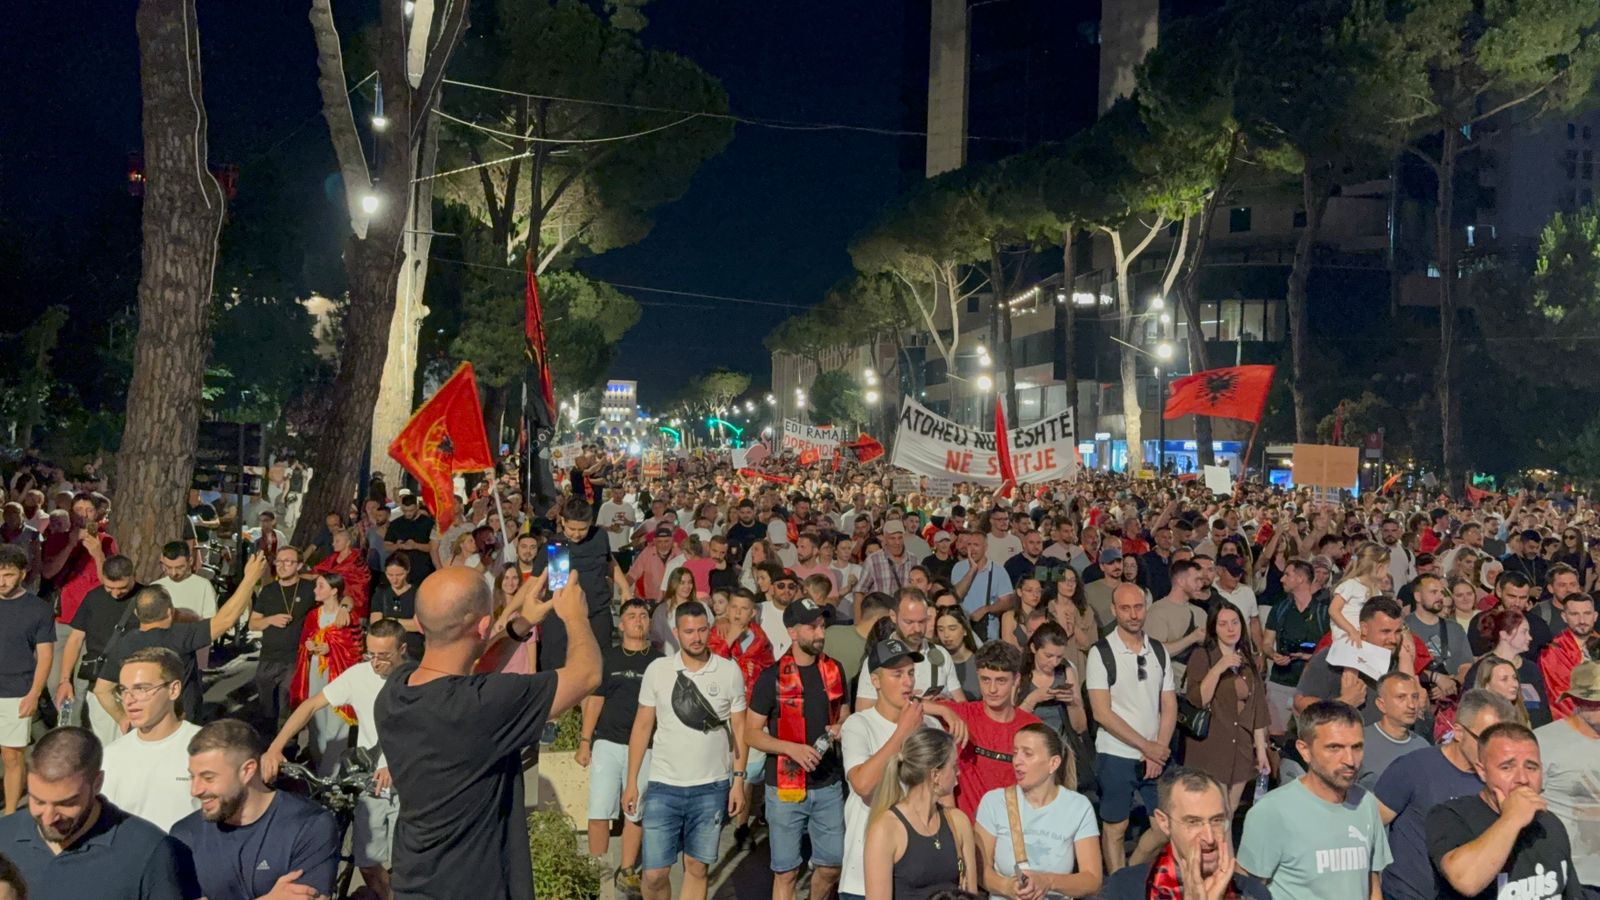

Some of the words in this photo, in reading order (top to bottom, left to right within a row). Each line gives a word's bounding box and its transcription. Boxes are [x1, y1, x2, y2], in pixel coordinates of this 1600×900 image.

[785, 420, 801, 434] EDI
[806, 427, 839, 441] RAMA
[974, 431, 998, 451] NU
[986, 447, 1057, 477] SITJE
[1315, 846, 1368, 874] PUMA
